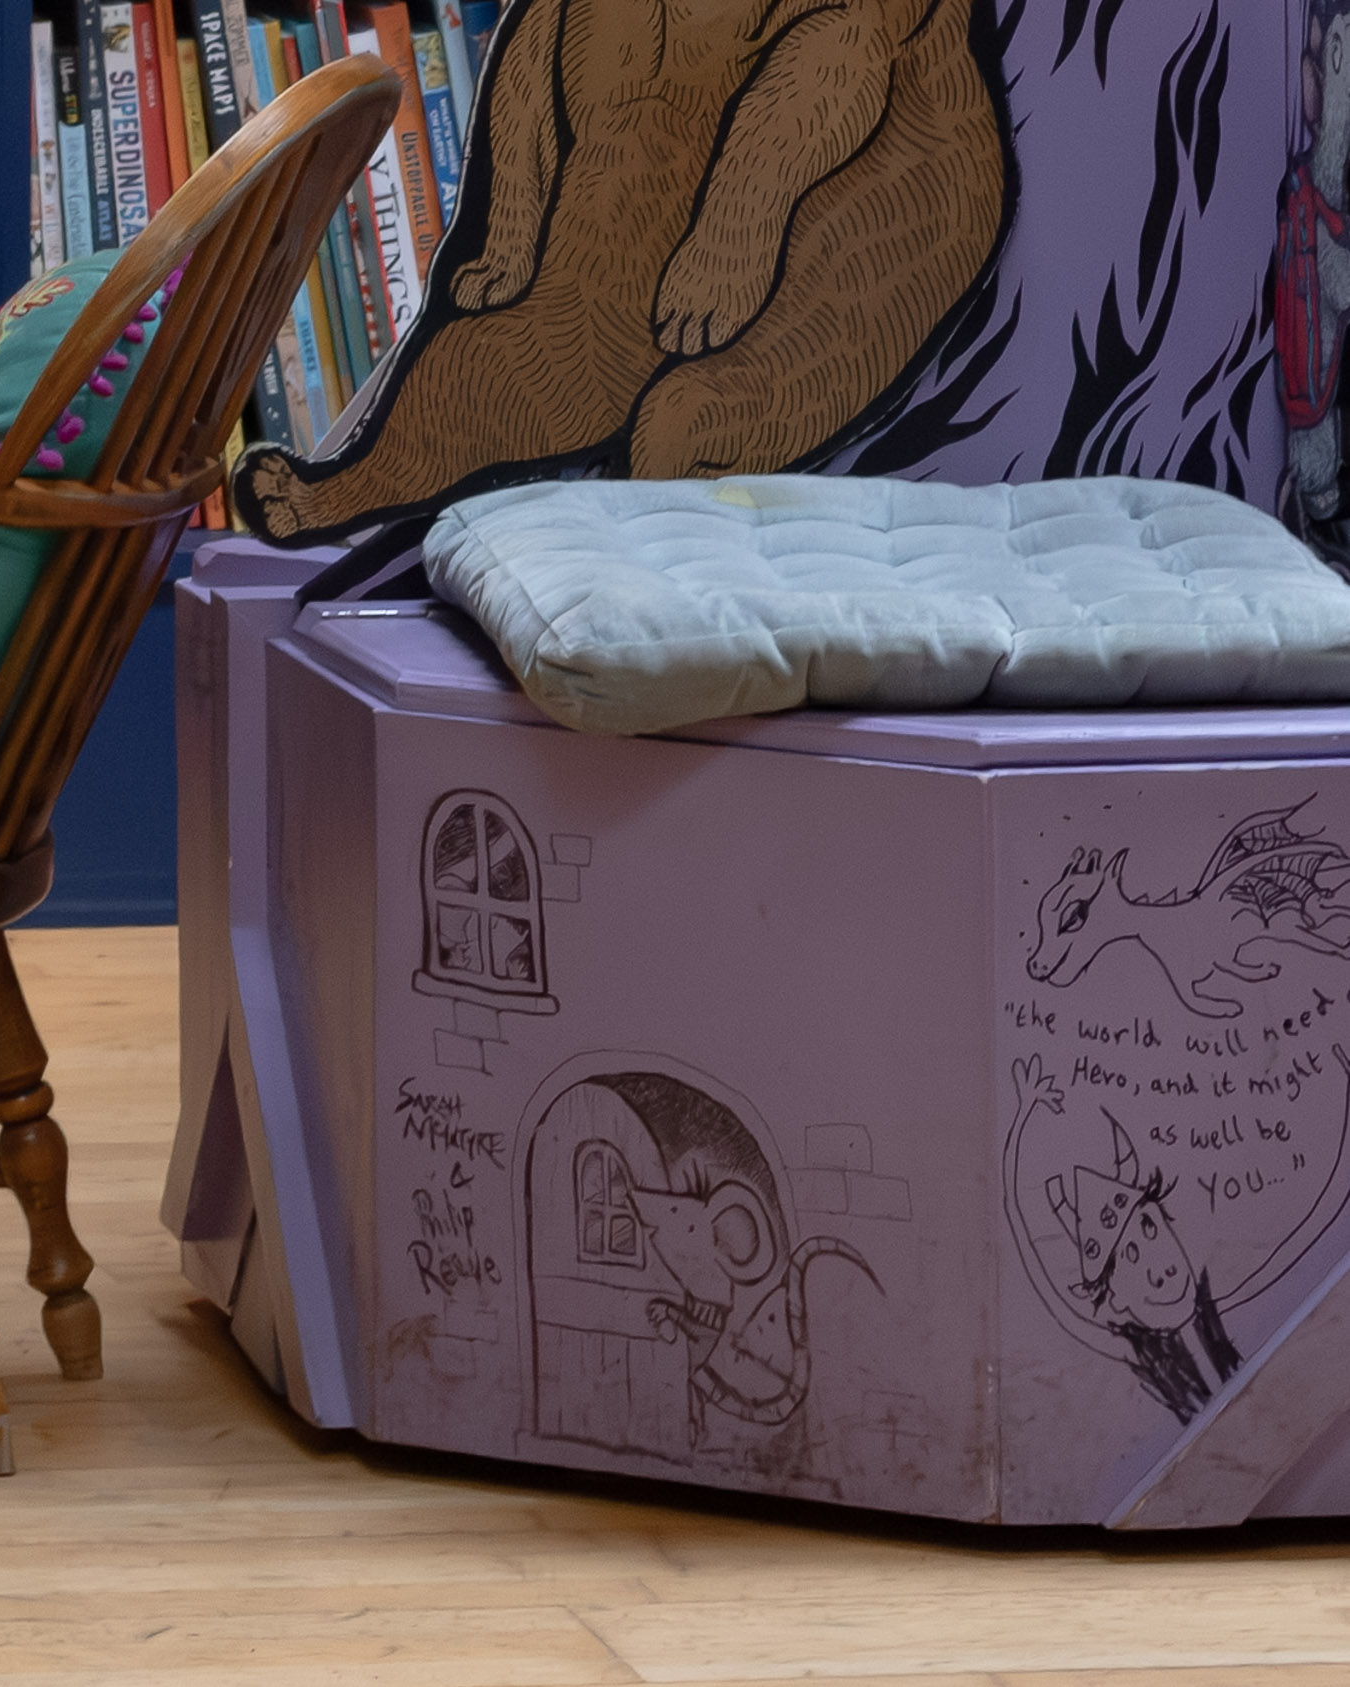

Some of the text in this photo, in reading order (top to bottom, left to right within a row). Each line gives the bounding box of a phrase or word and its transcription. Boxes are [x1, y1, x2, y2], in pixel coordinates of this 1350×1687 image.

[96, 199, 113, 242] ATLAS
[372, 181, 413, 327] THINGS
[1078, 1017, 1161, 1048] world
[1186, 1029, 1249, 1058] will
[1263, 987, 1335, 1043] need
[1071, 1051, 1324, 1102] Hero, and it might
[1151, 1115, 1293, 1150] as well be
